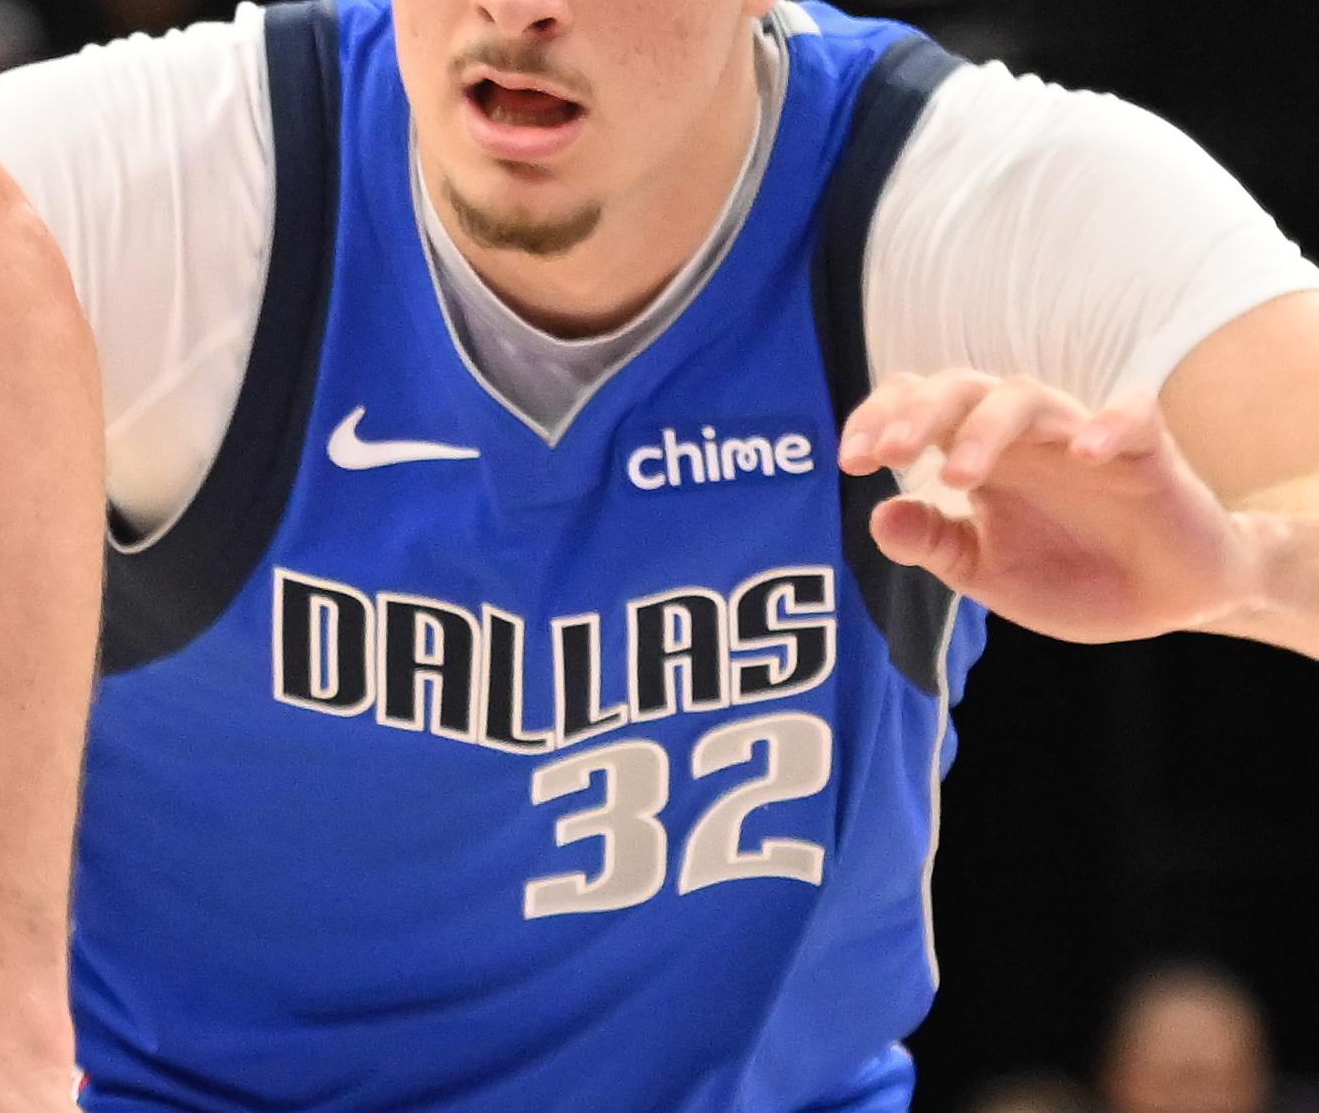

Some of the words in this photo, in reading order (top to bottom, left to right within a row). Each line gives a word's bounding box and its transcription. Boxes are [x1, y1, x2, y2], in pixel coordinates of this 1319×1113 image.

[627, 426, 814, 490] chime
[273, 565, 837, 755] DALLAS
[523, 711, 833, 920] 32
